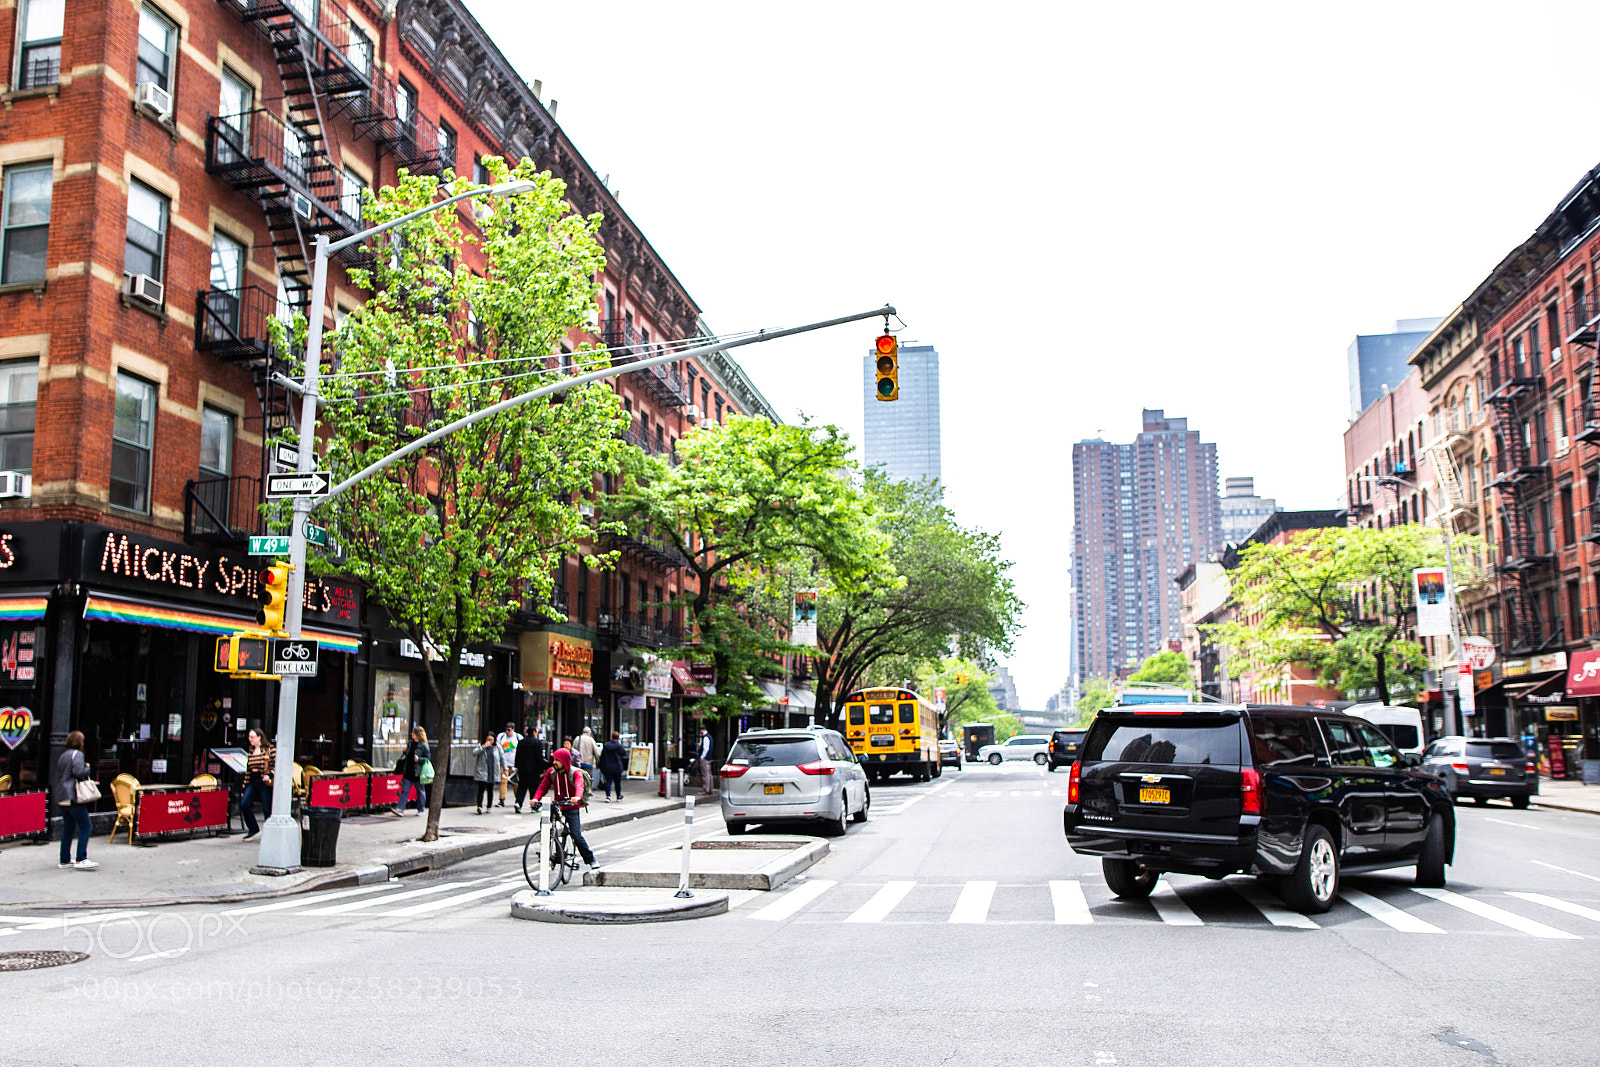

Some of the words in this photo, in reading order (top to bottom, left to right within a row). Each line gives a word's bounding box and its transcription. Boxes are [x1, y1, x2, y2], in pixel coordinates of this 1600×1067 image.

[276, 480, 293, 489] ONE
[302, 480, 320, 489] WAY
[308, 526, 315, 540] 9
[252, 539, 261, 552] W
[263, 538, 278, 552] 49
[279, 539, 288, 547] ST
[331, 598, 357, 611] KITCHEN
[336, 609, 351, 620] NYC
[275, 662, 293, 672] BIKE
[295, 662, 315, 672] LANE
[2, 713, 26, 738] 49
